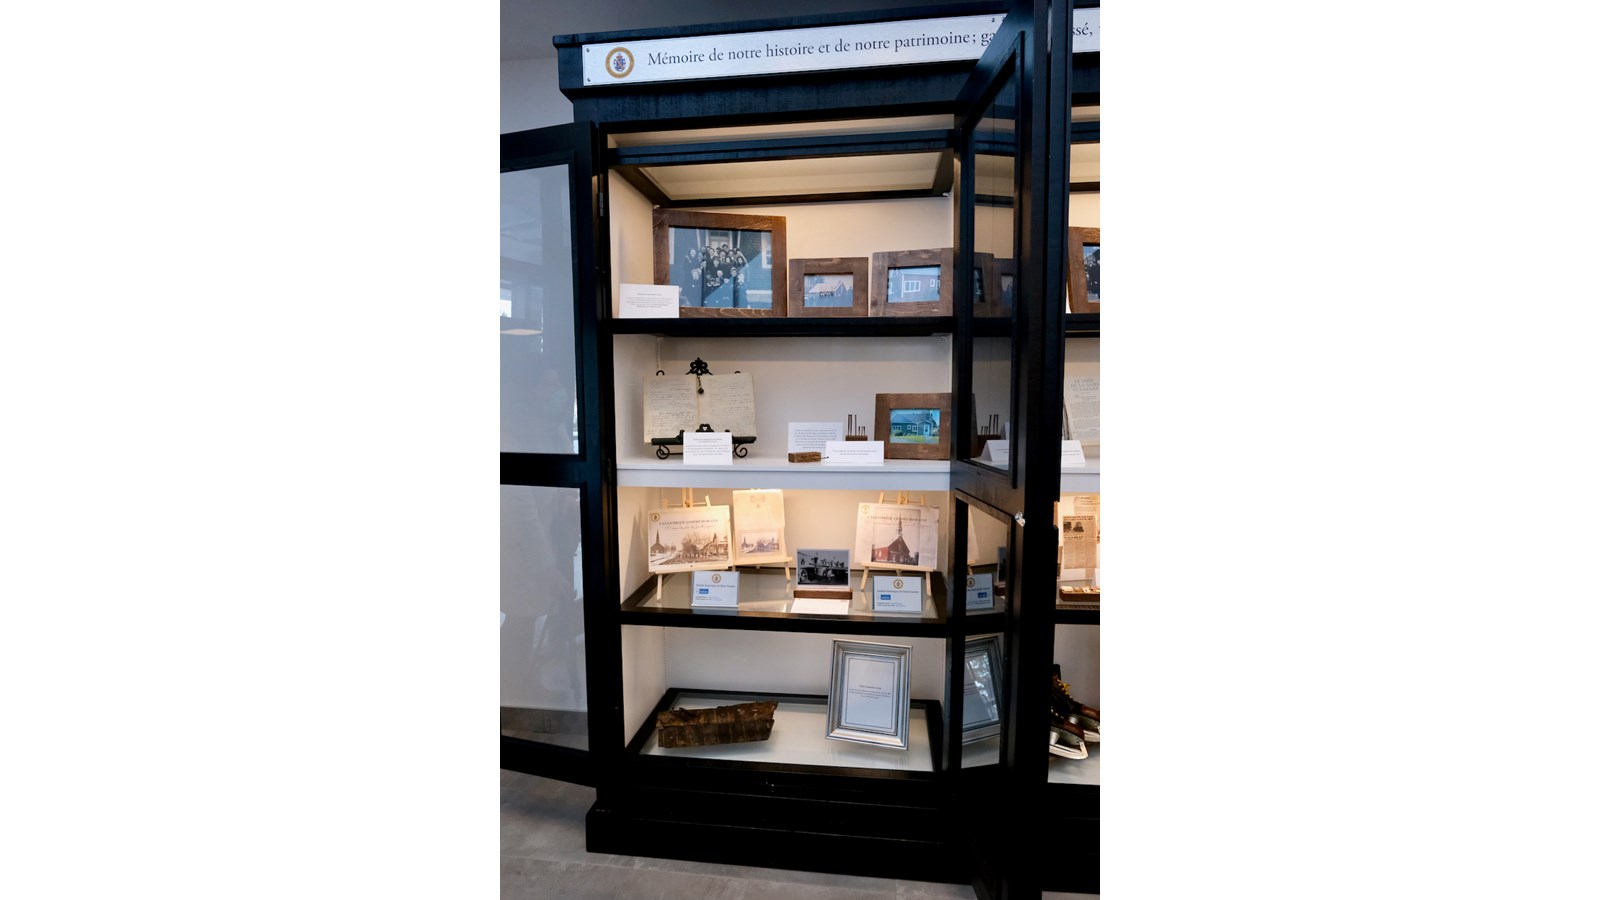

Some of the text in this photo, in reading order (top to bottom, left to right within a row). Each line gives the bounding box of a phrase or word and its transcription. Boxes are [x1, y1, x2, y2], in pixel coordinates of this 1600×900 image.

[647, 51, 705, 66] Mémoire
[708, 47, 724, 62] de
[728, 46, 762, 60] notre
[765, 43, 815, 58] histoire
[818, 43, 830, 55] et
[834, 39, 850, 53] de
[855, 39, 891, 51] notre
[1072, 22, 1093, 37] ssé,
